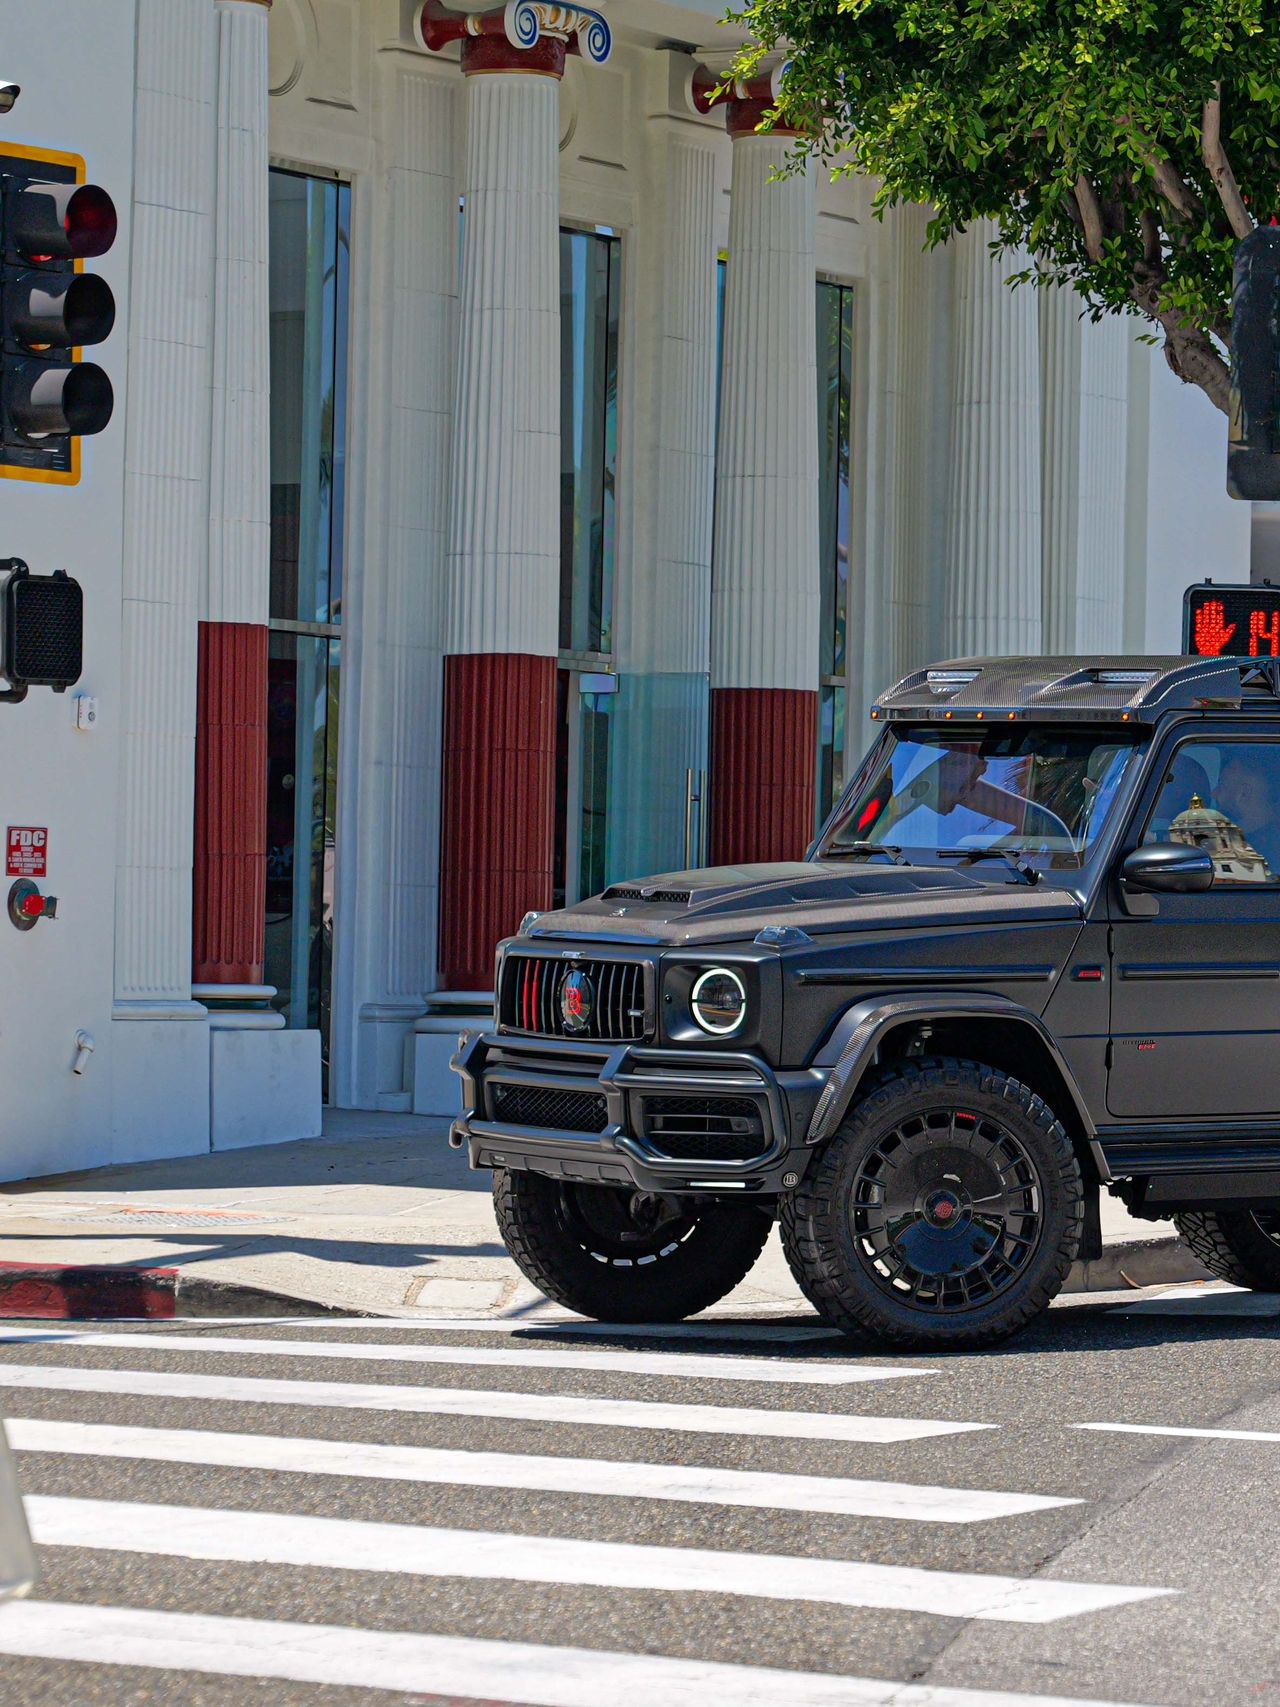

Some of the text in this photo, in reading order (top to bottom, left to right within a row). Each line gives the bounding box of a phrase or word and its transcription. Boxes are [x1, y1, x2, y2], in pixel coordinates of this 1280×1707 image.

[1249, 610, 1280, 658] 14
[10, 830, 46, 847] FDC
[565, 987, 583, 1015] B
